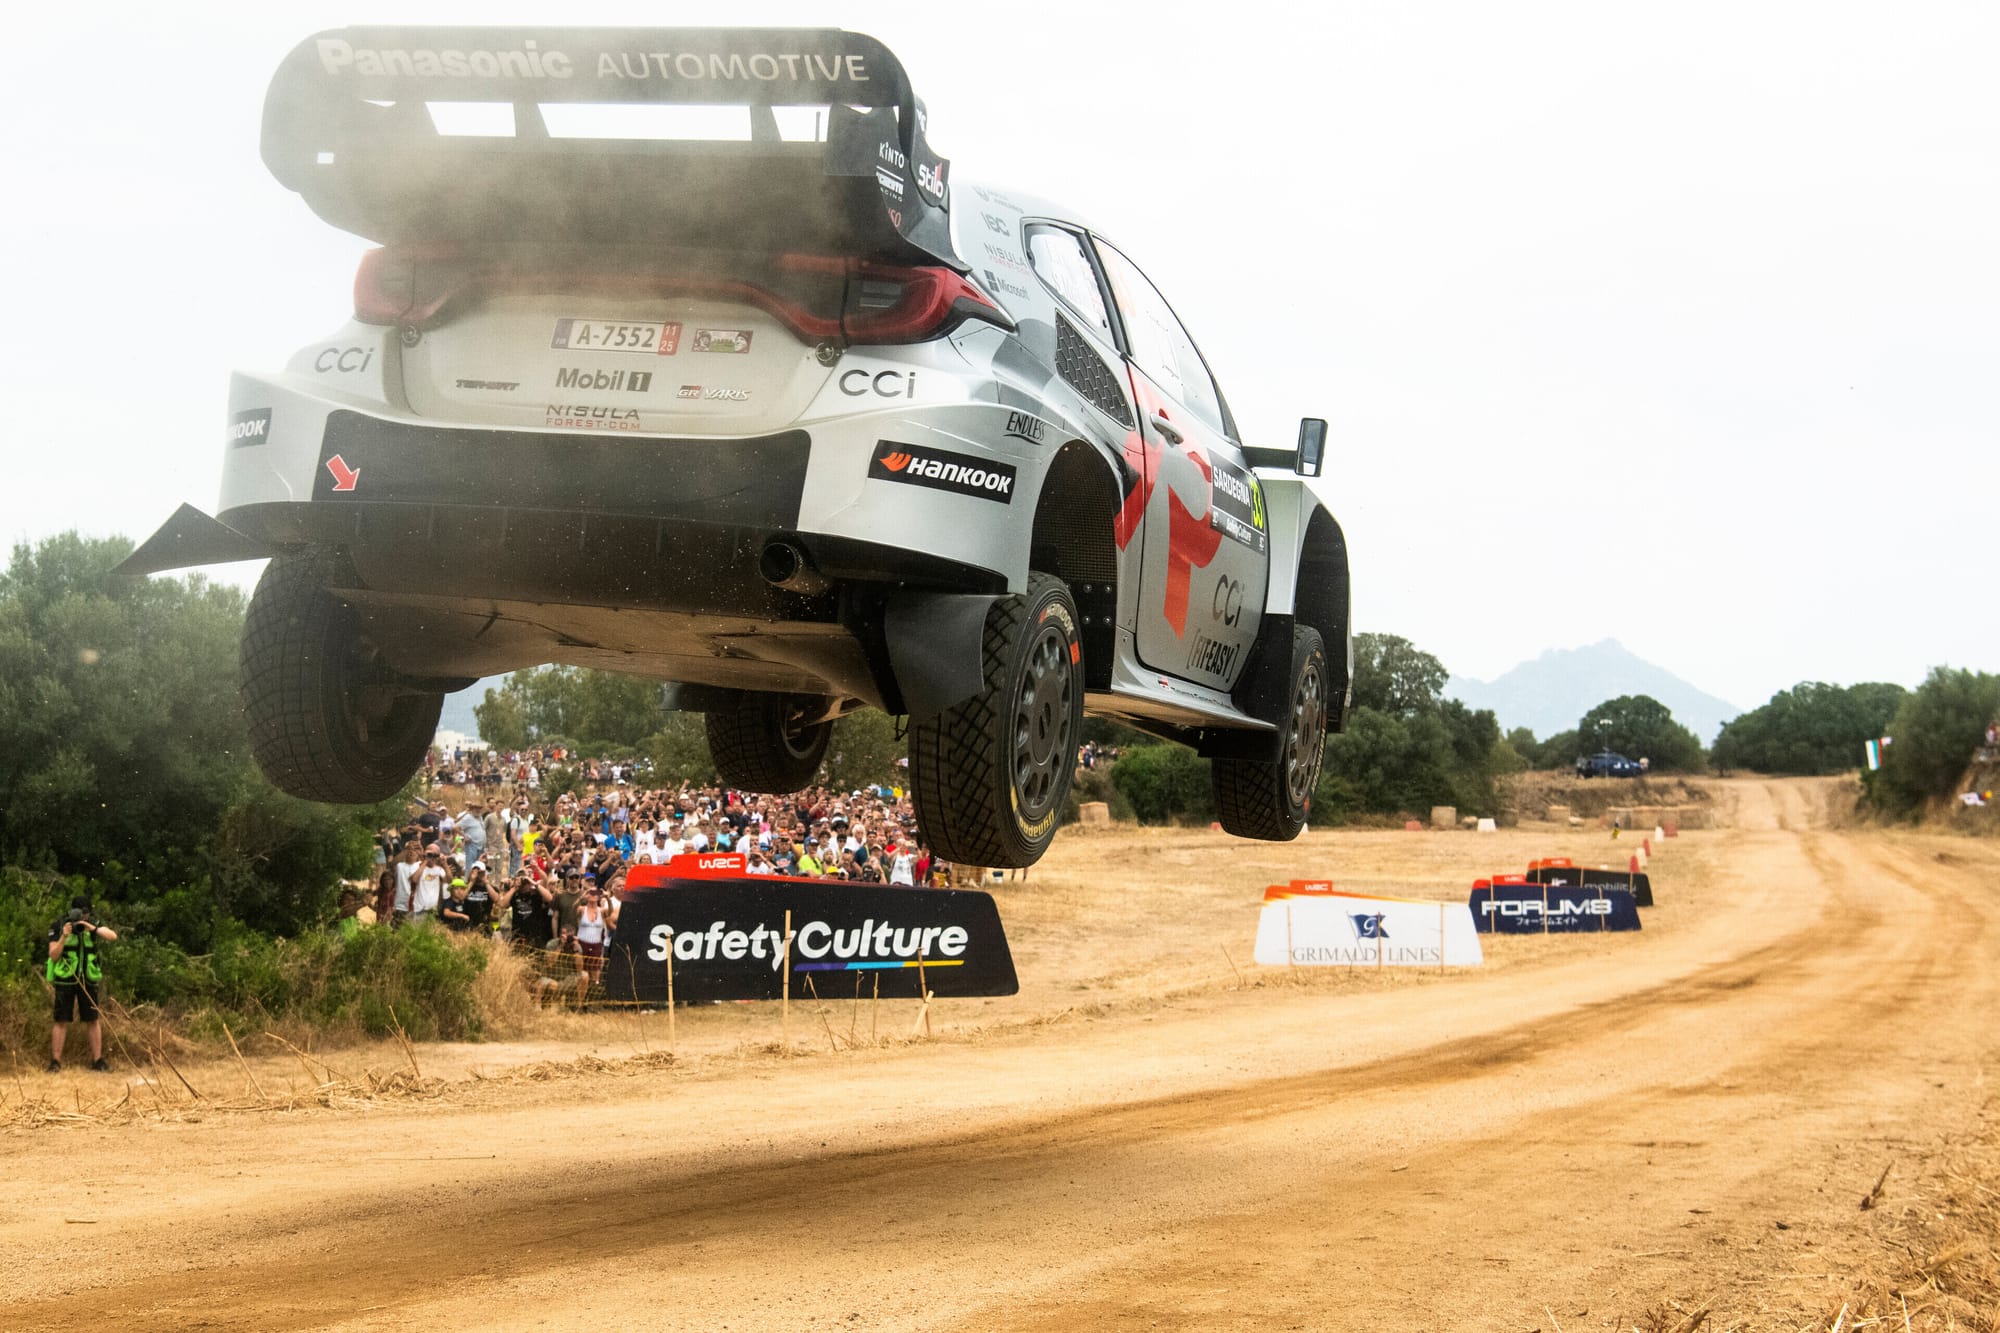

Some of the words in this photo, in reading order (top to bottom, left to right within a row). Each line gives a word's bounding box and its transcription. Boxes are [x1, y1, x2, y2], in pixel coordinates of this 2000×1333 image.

[316, 39, 573, 79] Panasonic
[597, 51, 869, 82] AUTOMOTIVE
[918, 162, 943, 199] Stilo
[576, 324, 656, 348] A-7552
[664, 325, 678, 336] 11
[659, 340, 674, 352] 25
[555, 367, 625, 391] Mobil
[546, 404, 641, 420] NISULA
[1006, 411, 1046, 441] ENDLESS
[1213, 465, 1251, 508] SARDEGNA
[699, 857, 742, 869] WRC
[1304, 883, 1329, 892] WRC
[1481, 898, 1613, 916] FORUM8
[1292, 946, 1380, 963] GRIMALD
[1388, 947, 1441, 962] LINES
